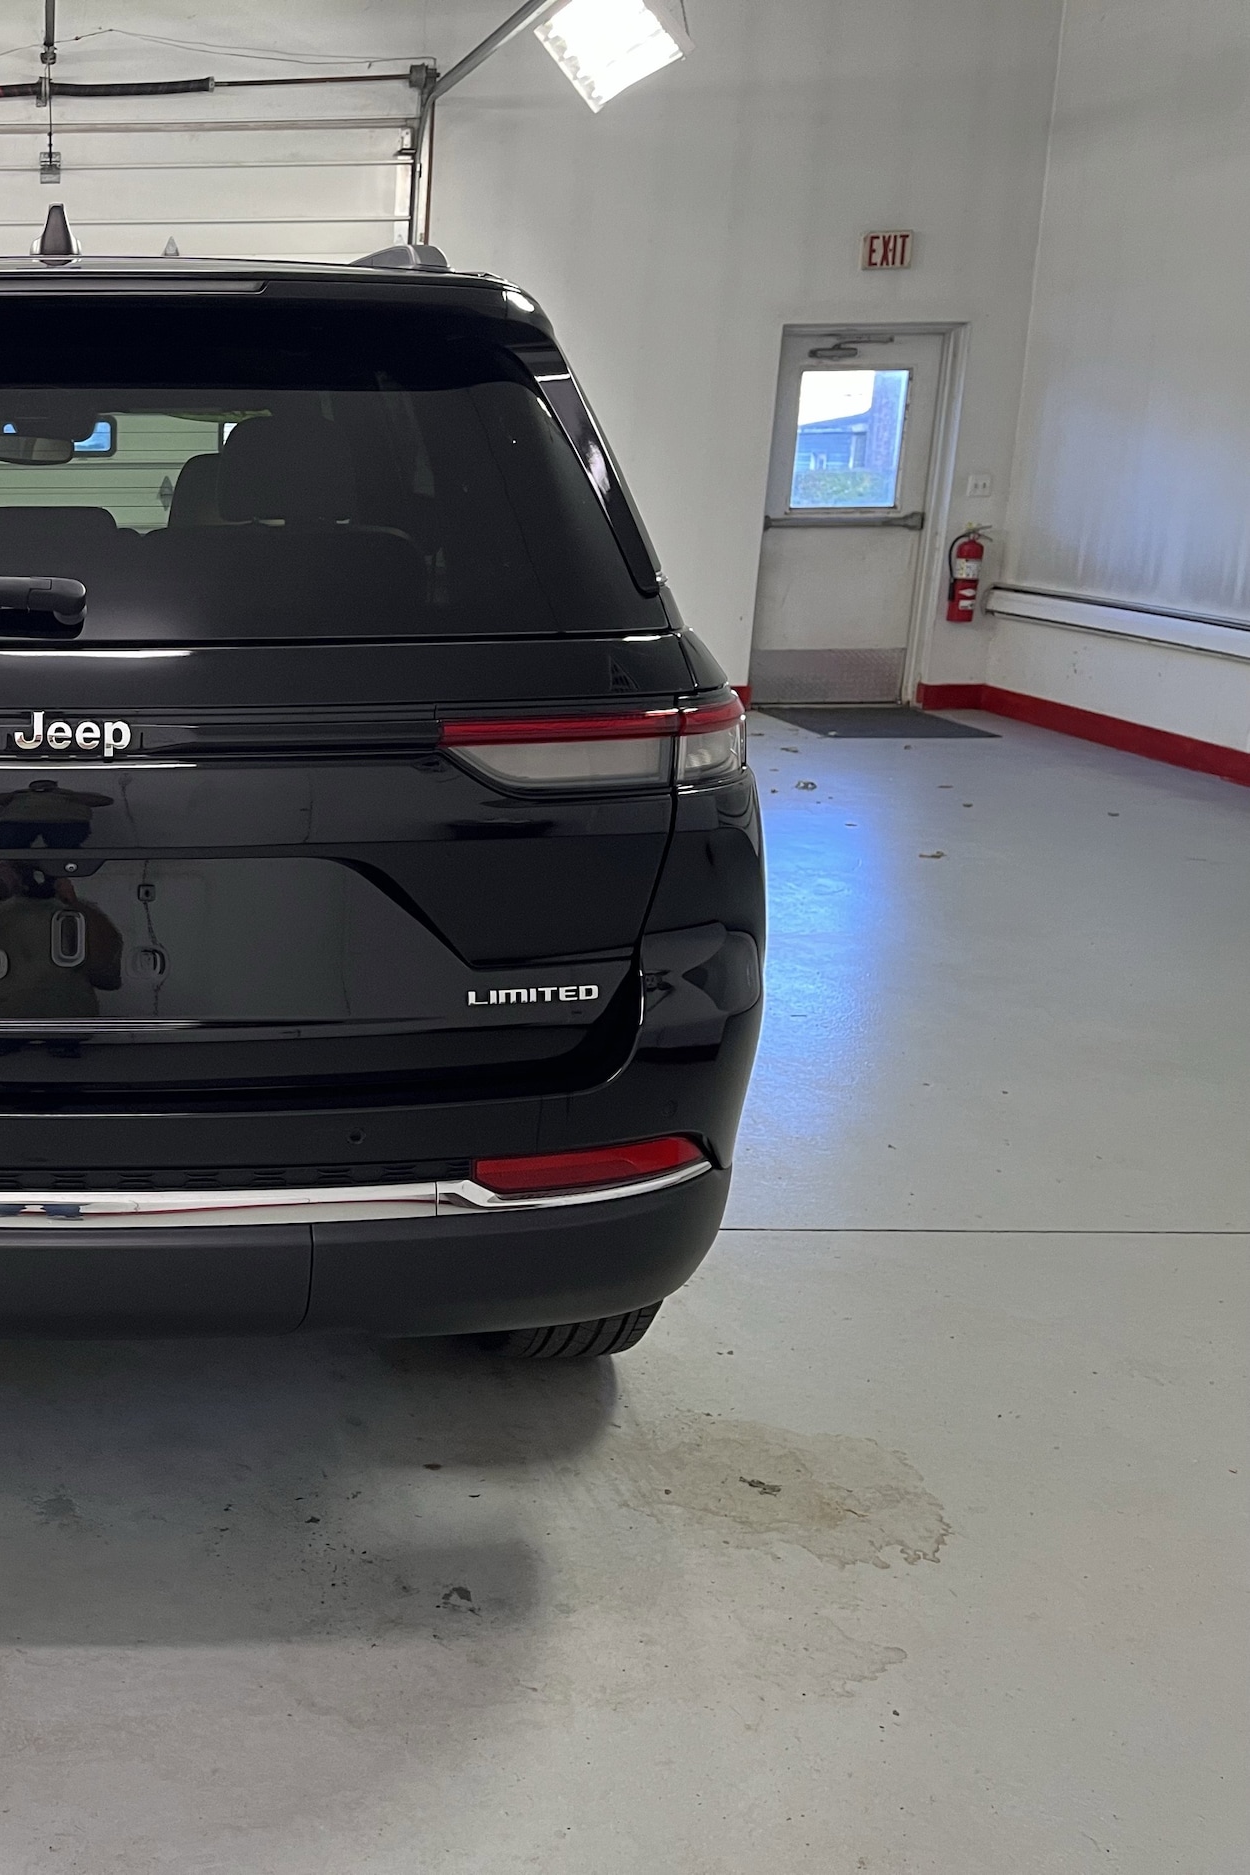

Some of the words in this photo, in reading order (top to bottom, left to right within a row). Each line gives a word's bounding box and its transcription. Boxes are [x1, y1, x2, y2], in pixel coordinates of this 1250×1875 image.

[868, 234, 910, 267] EXIT
[14, 710, 131, 757] Jeep
[467, 984, 599, 1006] LIMITED
